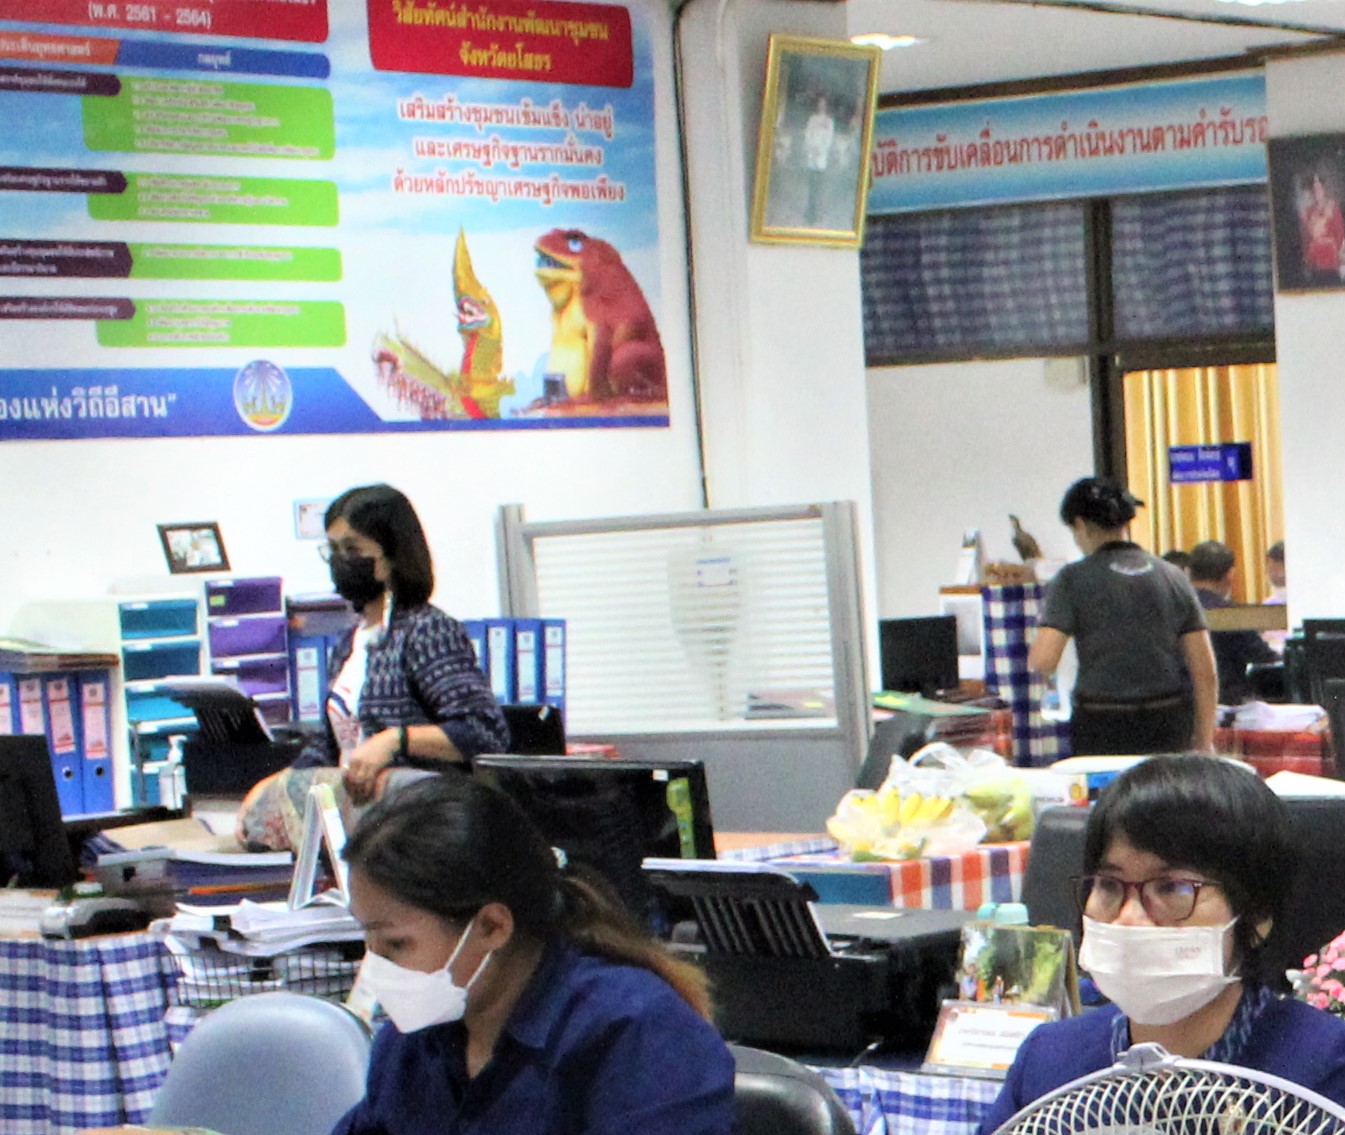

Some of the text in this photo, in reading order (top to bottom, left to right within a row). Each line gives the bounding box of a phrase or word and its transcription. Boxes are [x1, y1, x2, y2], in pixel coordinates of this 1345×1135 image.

[399, 96, 613, 138] เสริมสร้างชุมชนเข้มแข็ง น่าอยู่
[415, 135, 603, 167] และเศรษฐกิจฐานรากมั่นคง
[867, 107, 1269, 181] บัติการขับเคลื่อนการดำเนินงานตามคำรับรอ
